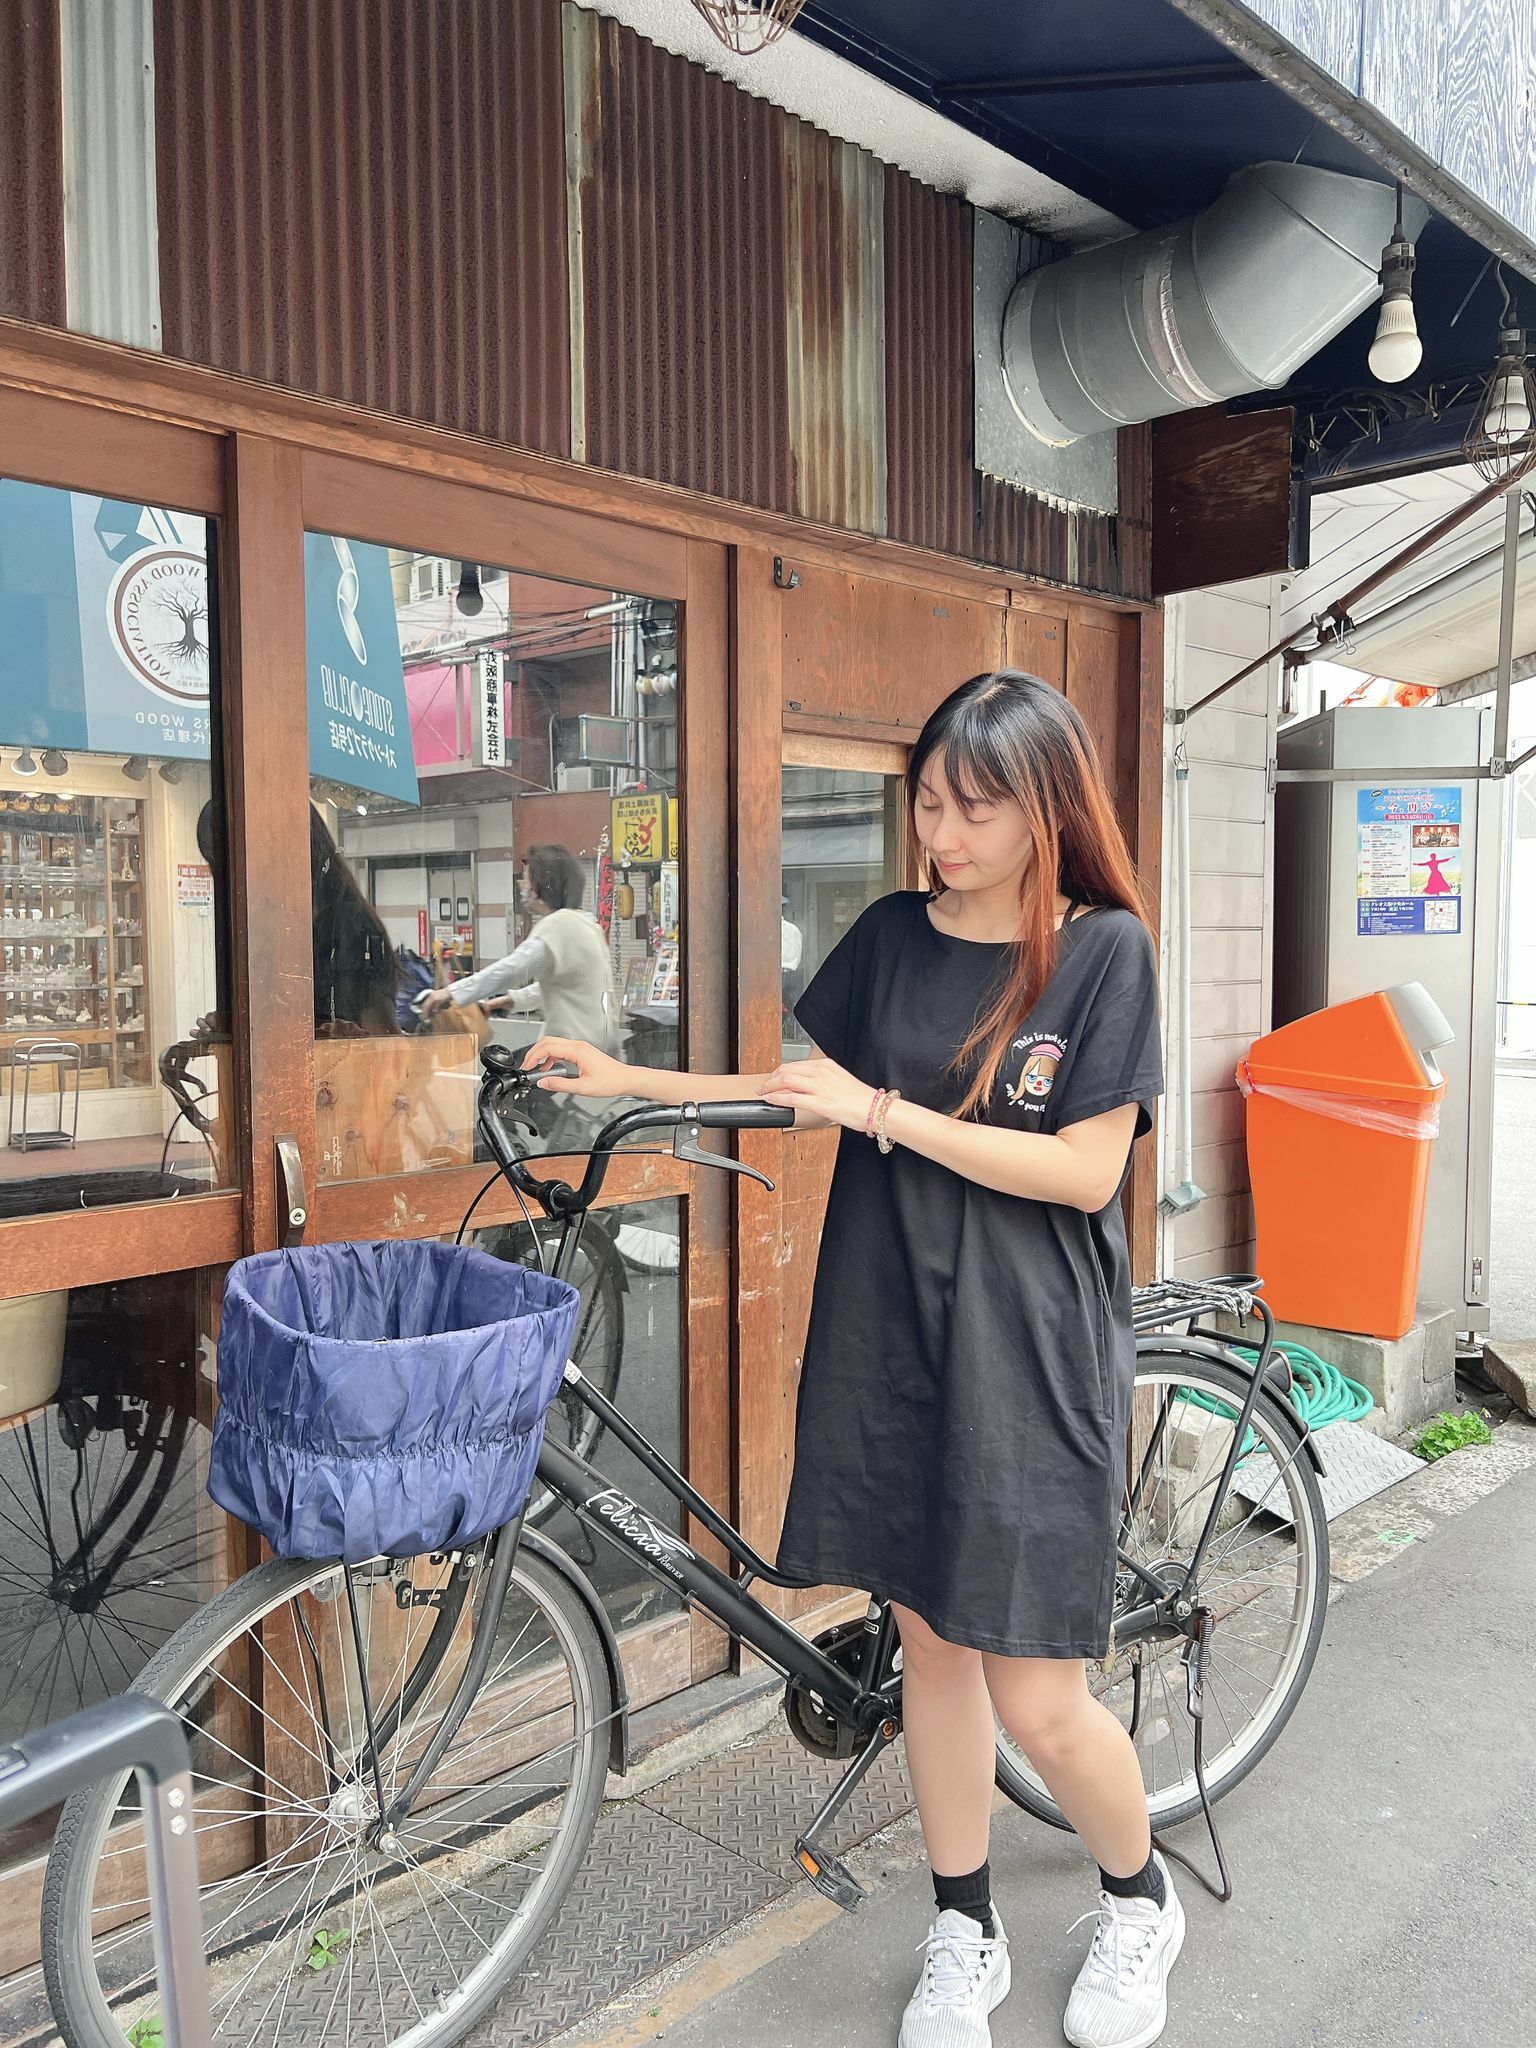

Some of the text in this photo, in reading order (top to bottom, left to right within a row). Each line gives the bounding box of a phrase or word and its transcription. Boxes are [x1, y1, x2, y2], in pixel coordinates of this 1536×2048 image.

[1013, 1036, 1034, 1050] This
[1033, 1032, 1044, 1041] is
[1044, 1033, 1059, 1043] not
[656, 1557, 684, 1580] FOREVER
